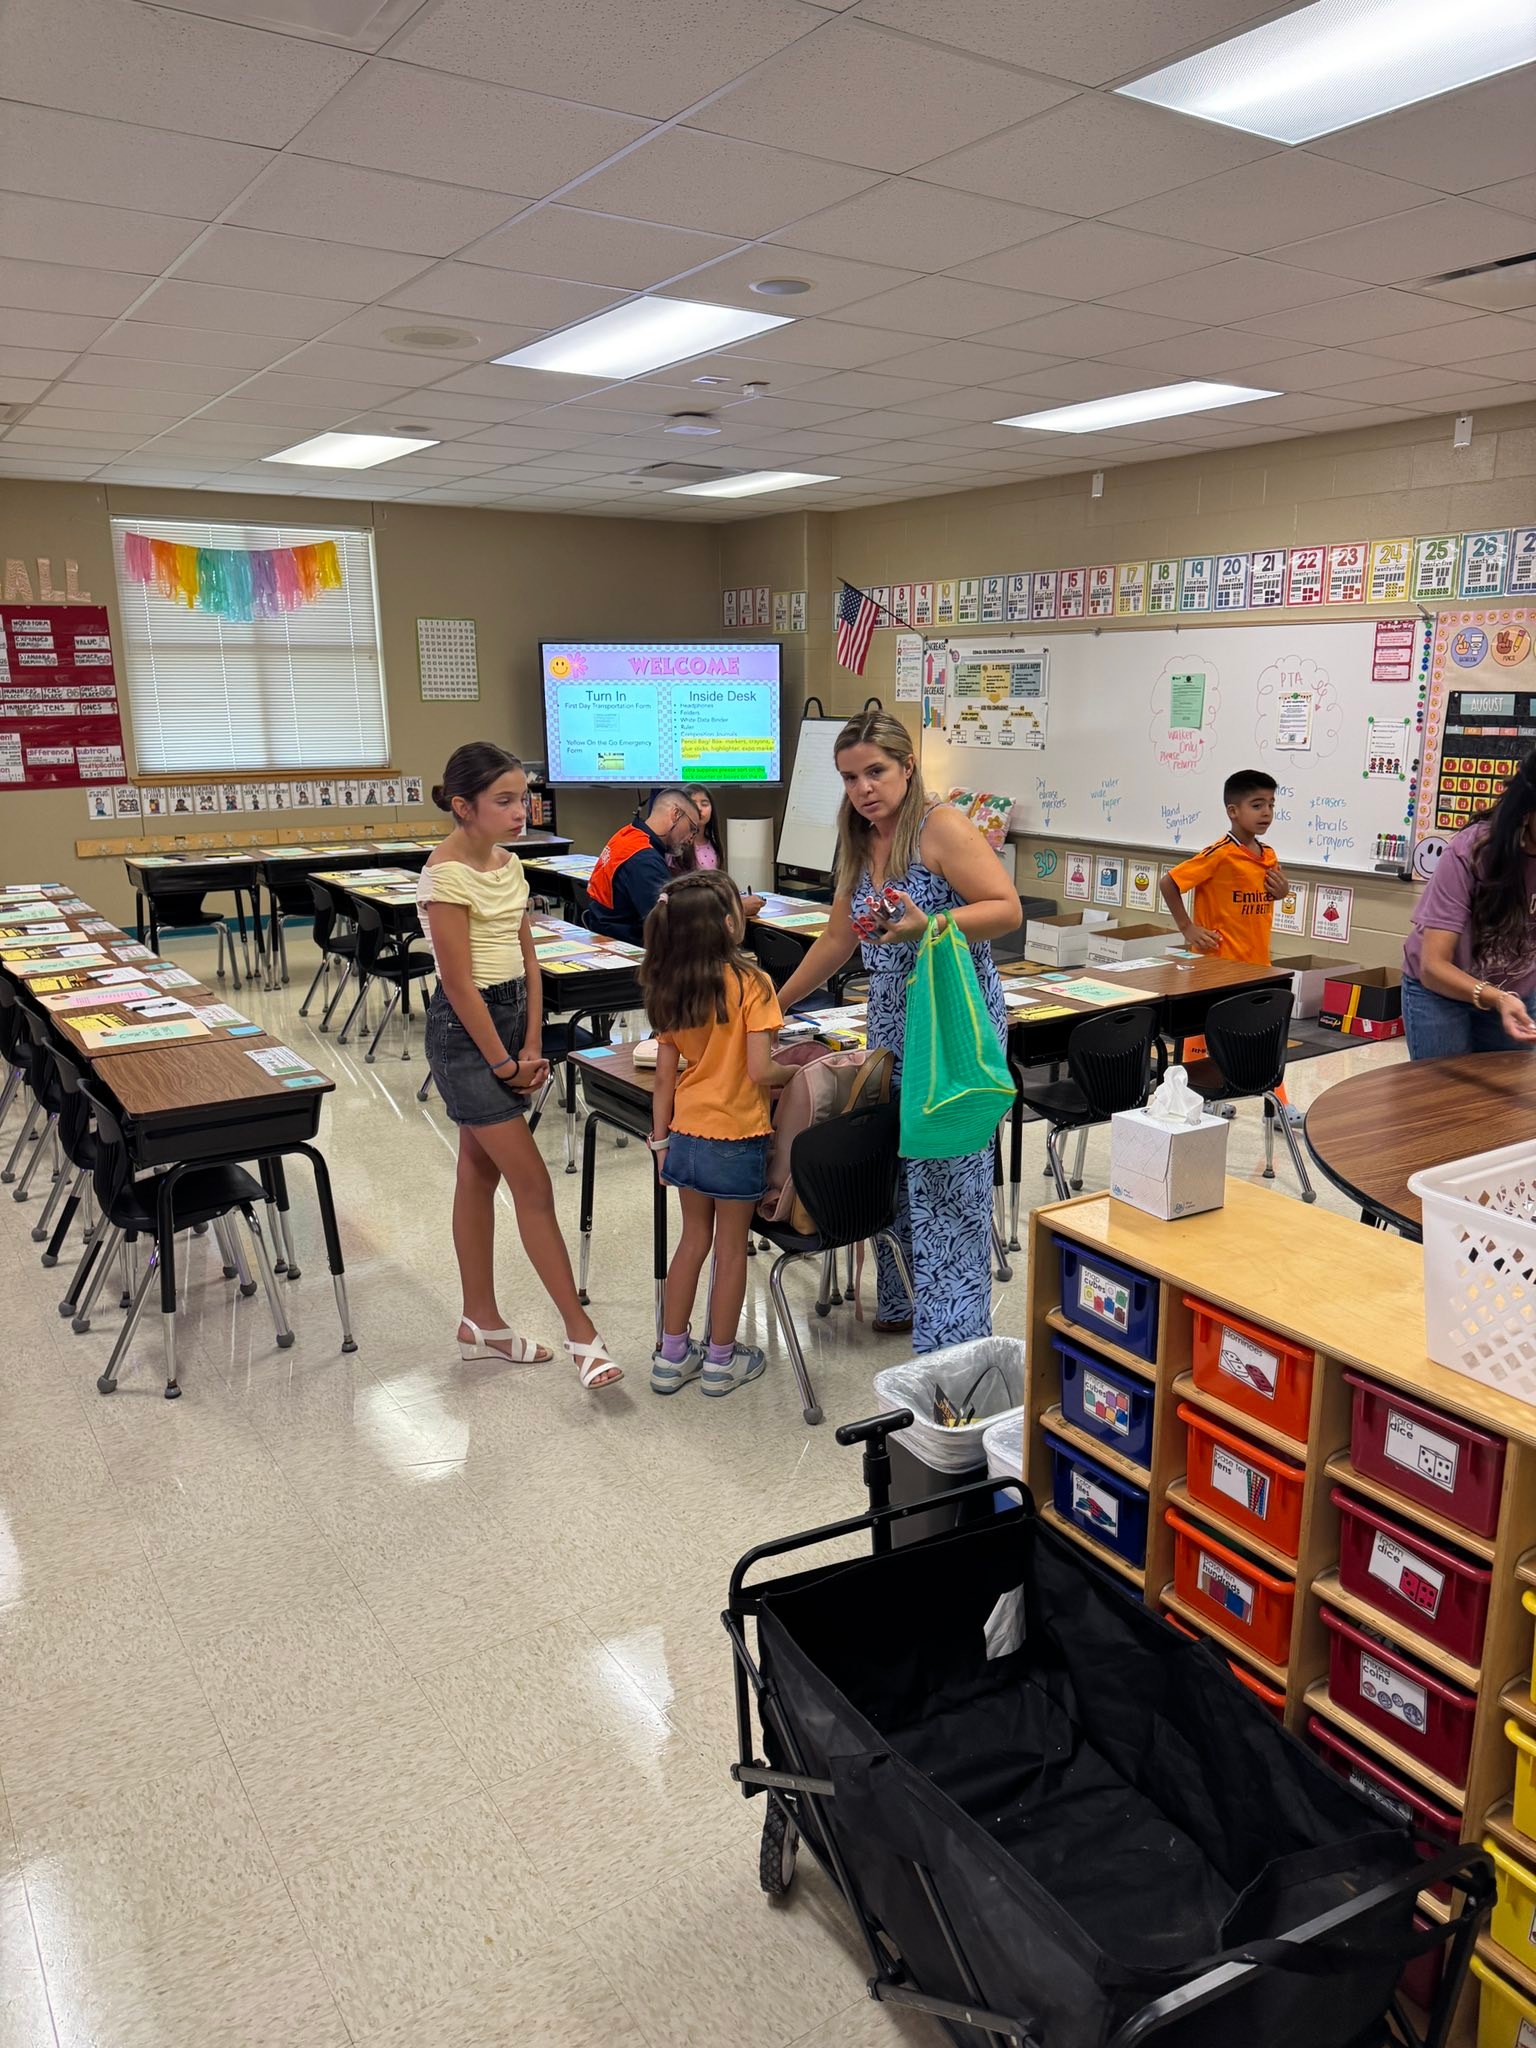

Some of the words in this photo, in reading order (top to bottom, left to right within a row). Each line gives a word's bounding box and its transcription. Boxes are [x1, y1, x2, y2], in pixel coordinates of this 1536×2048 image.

[1380, 544, 1402, 564] 24
[1425, 540, 1449, 560] 25
[1473, 536, 1498, 557] 26
[1262, 555, 1275, 572] 21
[1297, 552, 1318, 570] 22
[1337, 548, 1358, 567] 23
[1127, 567, 1138, 583] 17
[1158, 564, 1170, 580] 18
[1191, 561, 1204, 577] 19
[1222, 558, 1241, 576] 20
[0, 558, 92, 603] ALL
[1014, 578, 1023, 592] 13
[1040, 575, 1050, 589] 14
[1068, 573, 1078, 587] 15
[1096, 570, 1108, 586] 16
[1222, 576, 1241, 584] twenty
[760, 589, 766, 601] 2
[899, 588, 905, 600] 8
[920, 585, 927, 599] 9
[942, 583, 951, 599] 10
[966, 582, 972, 595] 11
[988, 580, 998, 594] 12
[727, 592, 733, 604] 0
[744, 591, 748, 603] 1
[795, 594, 801, 607] 4
[878, 590, 884, 603] 7
[925, 642, 946, 651] INCREASE
[628, 656, 740, 676] WELCOME
[1281, 672, 1303, 688] PTA
[585, 690, 612, 701] Turn
[616, 690, 627, 701] In
[689, 691, 724, 702] Inside
[727, 691, 757, 702] Desk
[923, 686, 945, 695] DECREASE
[1471, 697, 1504, 712] AUGUST
[77, 747, 109, 755] subtract
[619, 739, 652, 747] Emergency
[27, 748, 70, 756] difference
[1173, 760, 1198, 770] return
[1161, 803, 1181, 818] Hand
[1274, 808, 1292, 821] icks
[1166, 810, 1202, 829] Sanitizer
[1315, 814, 1348, 832] Pencils
[1316, 833, 1355, 851] Crayons
[1033, 848, 1058, 879] 3D
[1232, 889, 1275, 904] Emira
[1241, 904, 1254, 915] FLY
[1084, 1270, 1101, 1283] snap
[1084, 1277, 1106, 1294] cubes
[1224, 1329, 1263, 1357] dominoes
[1085, 1381, 1107, 1398] cubes
[1389, 1423, 1414, 1440] dice
[1214, 1452, 1234, 1468] base
[1075, 1477, 1092, 1491] color
[1075, 1483, 1090, 1497] tiles
[1377, 1544, 1400, 1564] dice
[1378, 1535, 1404, 1557] foam
[1203, 1556, 1222, 1574] base
[1223, 1570, 1236, 1583] ten
[1202, 1562, 1241, 1595] hundreds
[1362, 1657, 1391, 1679] mixed
[1362, 1665, 1390, 1686] coins
